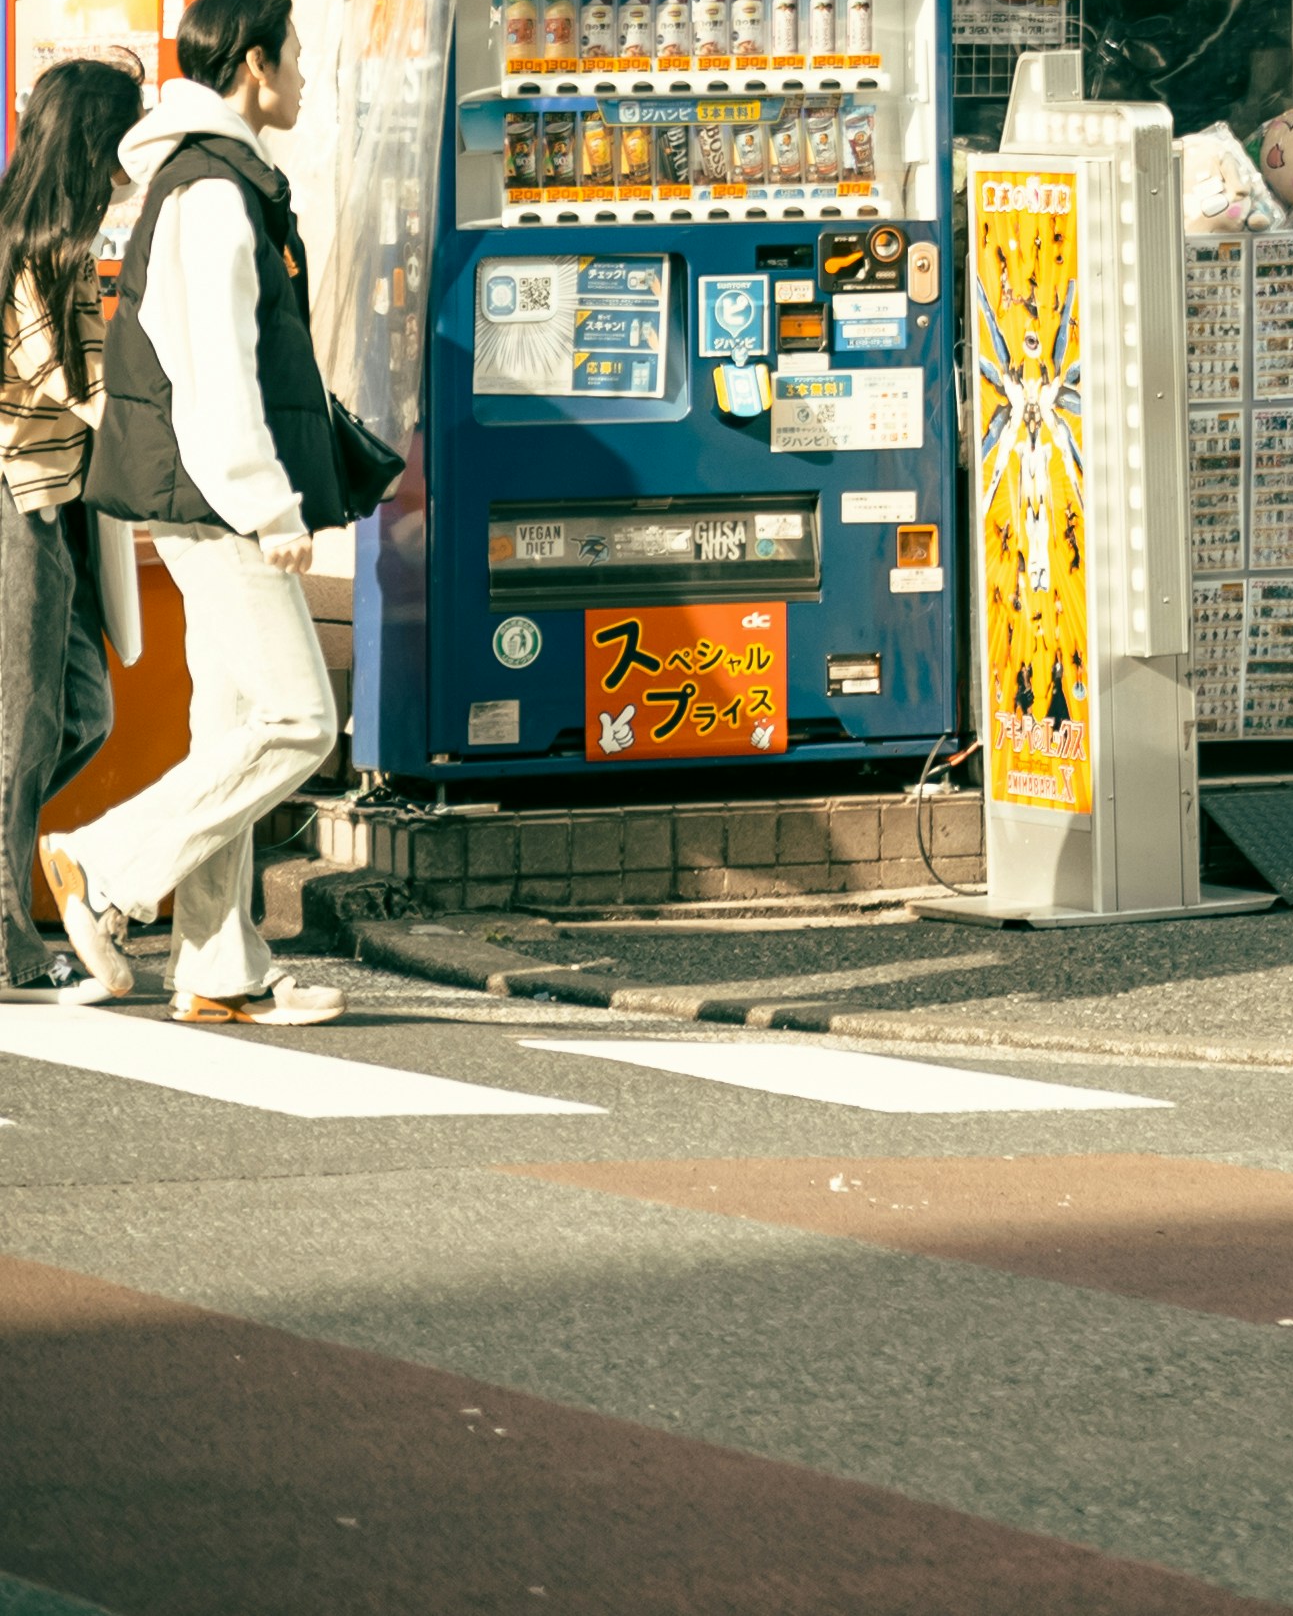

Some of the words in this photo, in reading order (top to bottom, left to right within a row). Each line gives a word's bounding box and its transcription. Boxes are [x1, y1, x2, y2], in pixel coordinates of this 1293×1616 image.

[641, 109, 692, 122] ジハンピ
[701, 106, 755, 119] 3本無料!
[705, 124, 726, 179] BOSS
[716, 281, 751, 290] SUNTORY
[585, 321, 625, 331] スキャン!
[714, 337, 757, 349] ジハンピ
[519, 525, 562, 540] VEGAN
[525, 540, 555, 557] DIET
[594, 617, 773, 691] スペシャル
[643, 685, 775, 741] プライス
